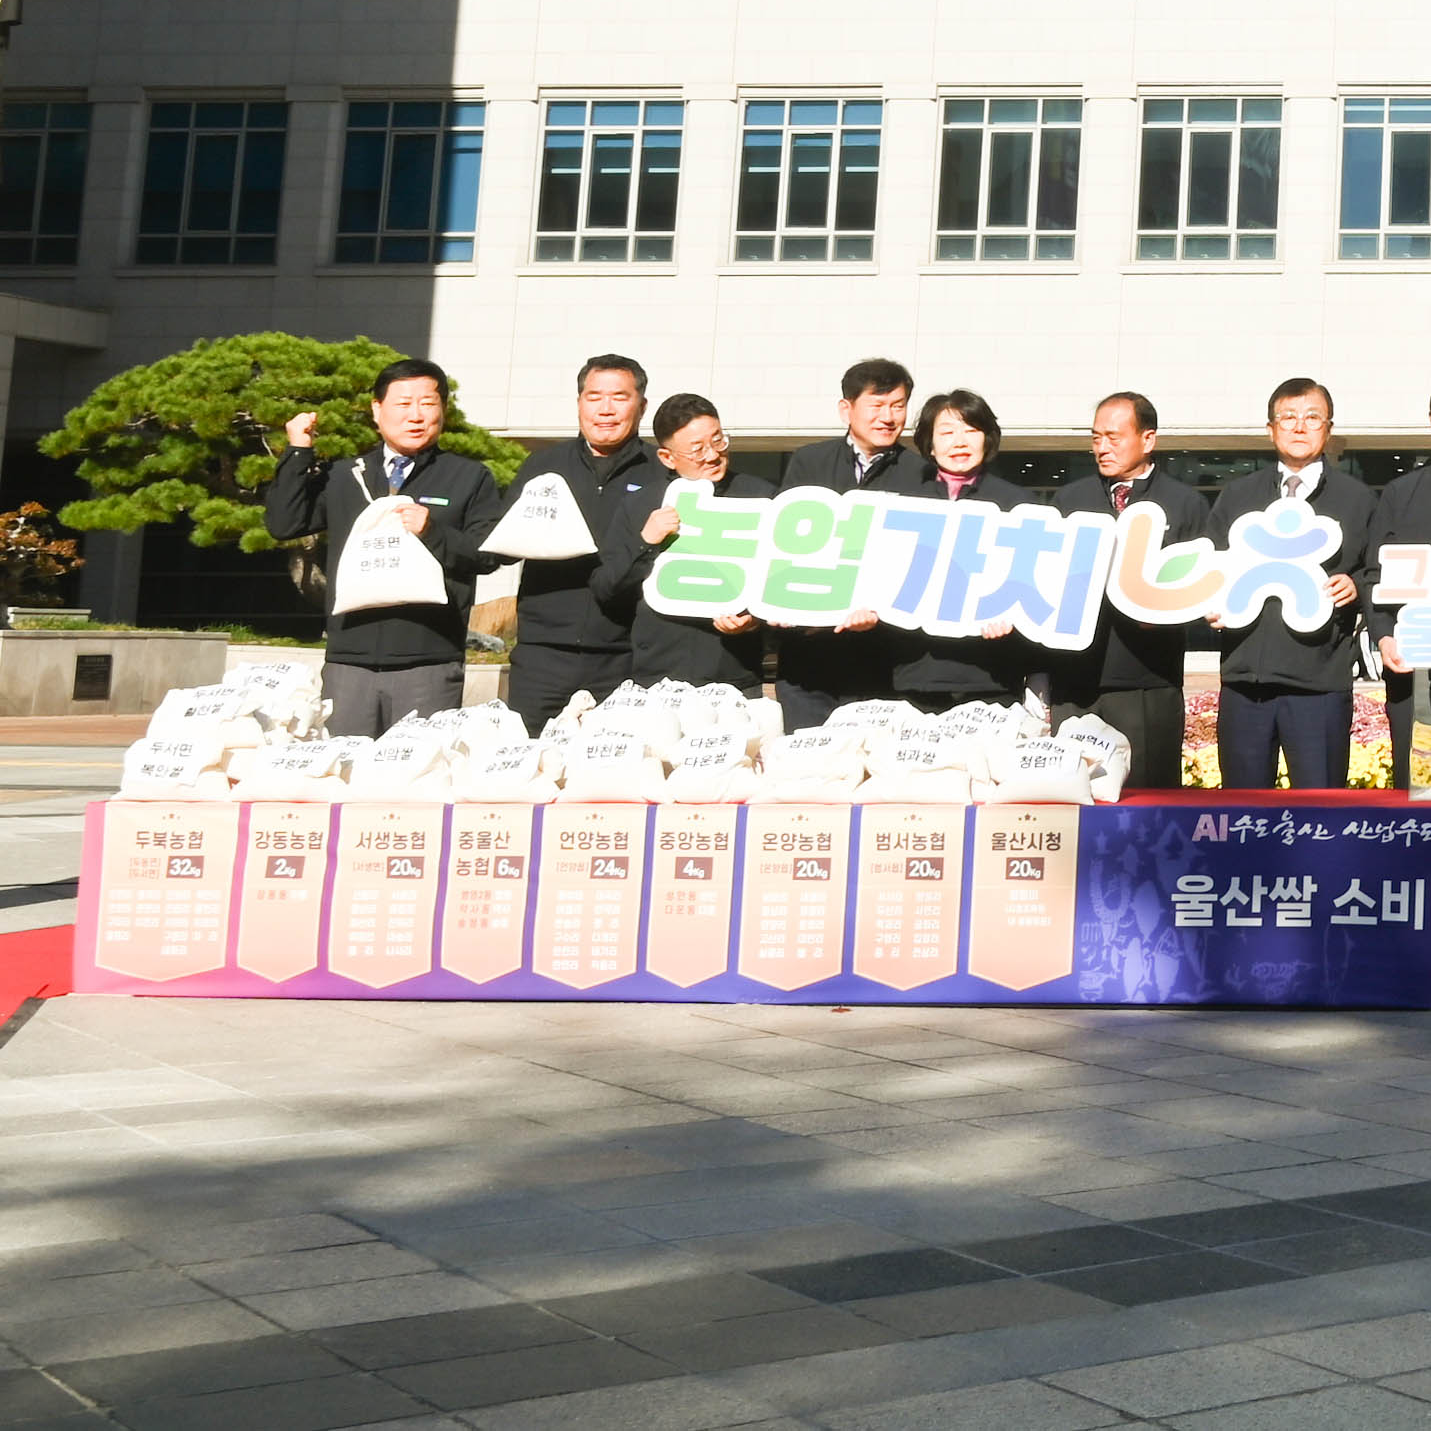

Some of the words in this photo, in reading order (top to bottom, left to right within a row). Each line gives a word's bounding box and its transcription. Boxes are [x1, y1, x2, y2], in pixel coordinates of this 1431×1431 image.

[655, 490, 1098, 636] 농업가치
[136, 831, 203, 850] 두북농협
[255, 831, 324, 849] 강동농협
[356, 831, 425, 850] 서생농협
[458, 831, 511, 850] 중울산
[560, 831, 629, 850] 언양농협
[660, 832, 729, 851] 중앙농협
[762, 832, 832, 851] 온양농협
[876, 832, 945, 851] 범서농협
[991, 832, 1062, 851] 울산시청
[456, 858, 489, 876] 농협
[1171, 874, 1319, 928] 울산쌀
[1330, 877, 1425, 931] 소비
